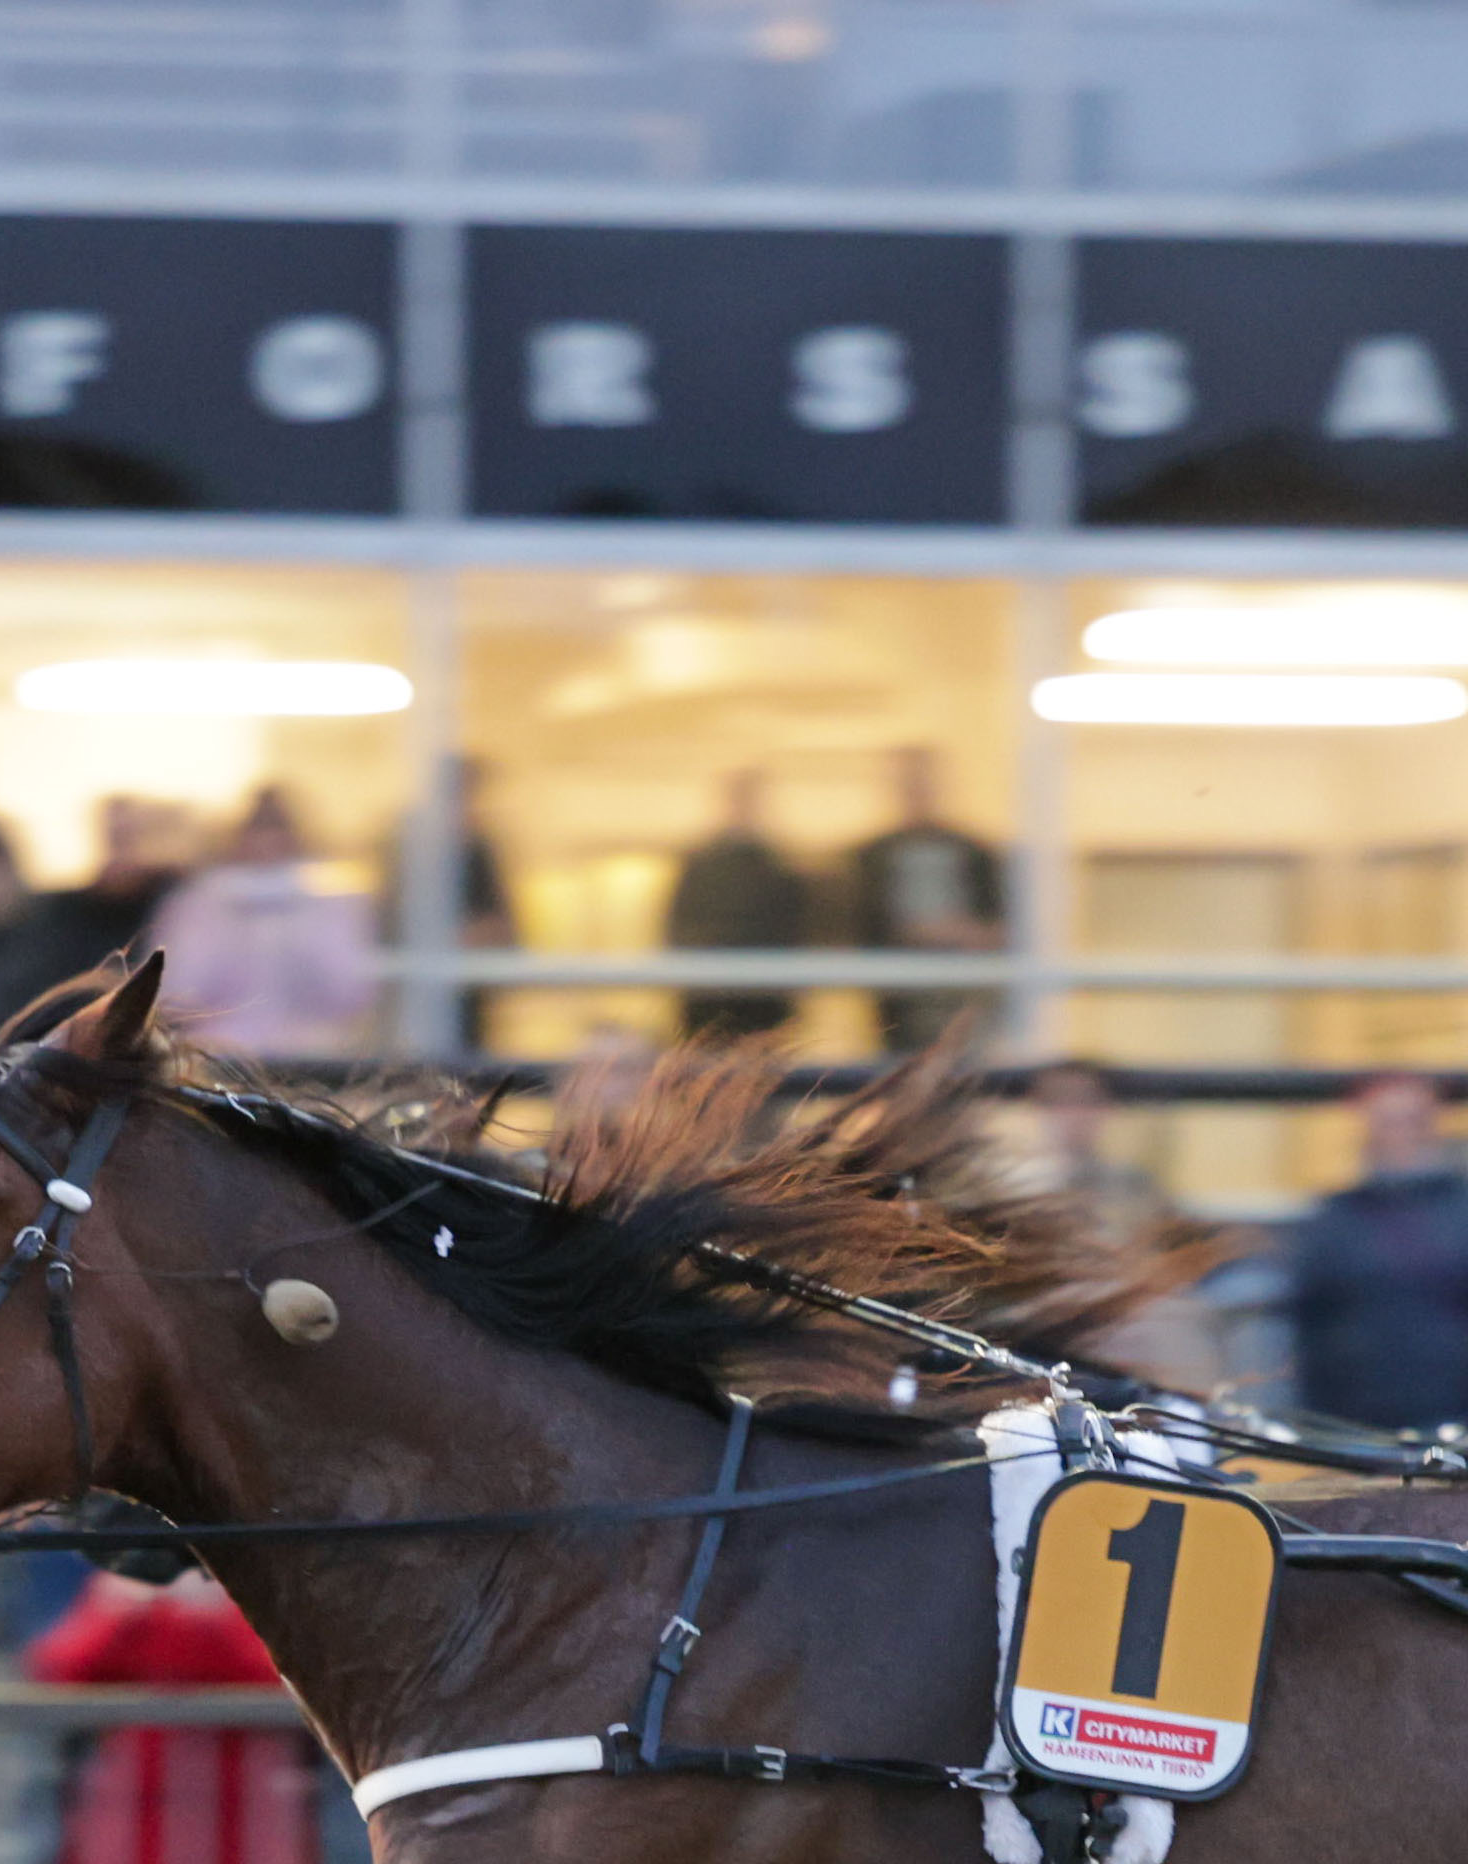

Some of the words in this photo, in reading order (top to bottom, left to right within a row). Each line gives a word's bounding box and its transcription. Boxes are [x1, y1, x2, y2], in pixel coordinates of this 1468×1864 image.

[1106, 1498, 1186, 1700] 1
[1042, 1706, 1073, 1738] K
[1084, 1719, 1208, 1756] CITYMARKET
